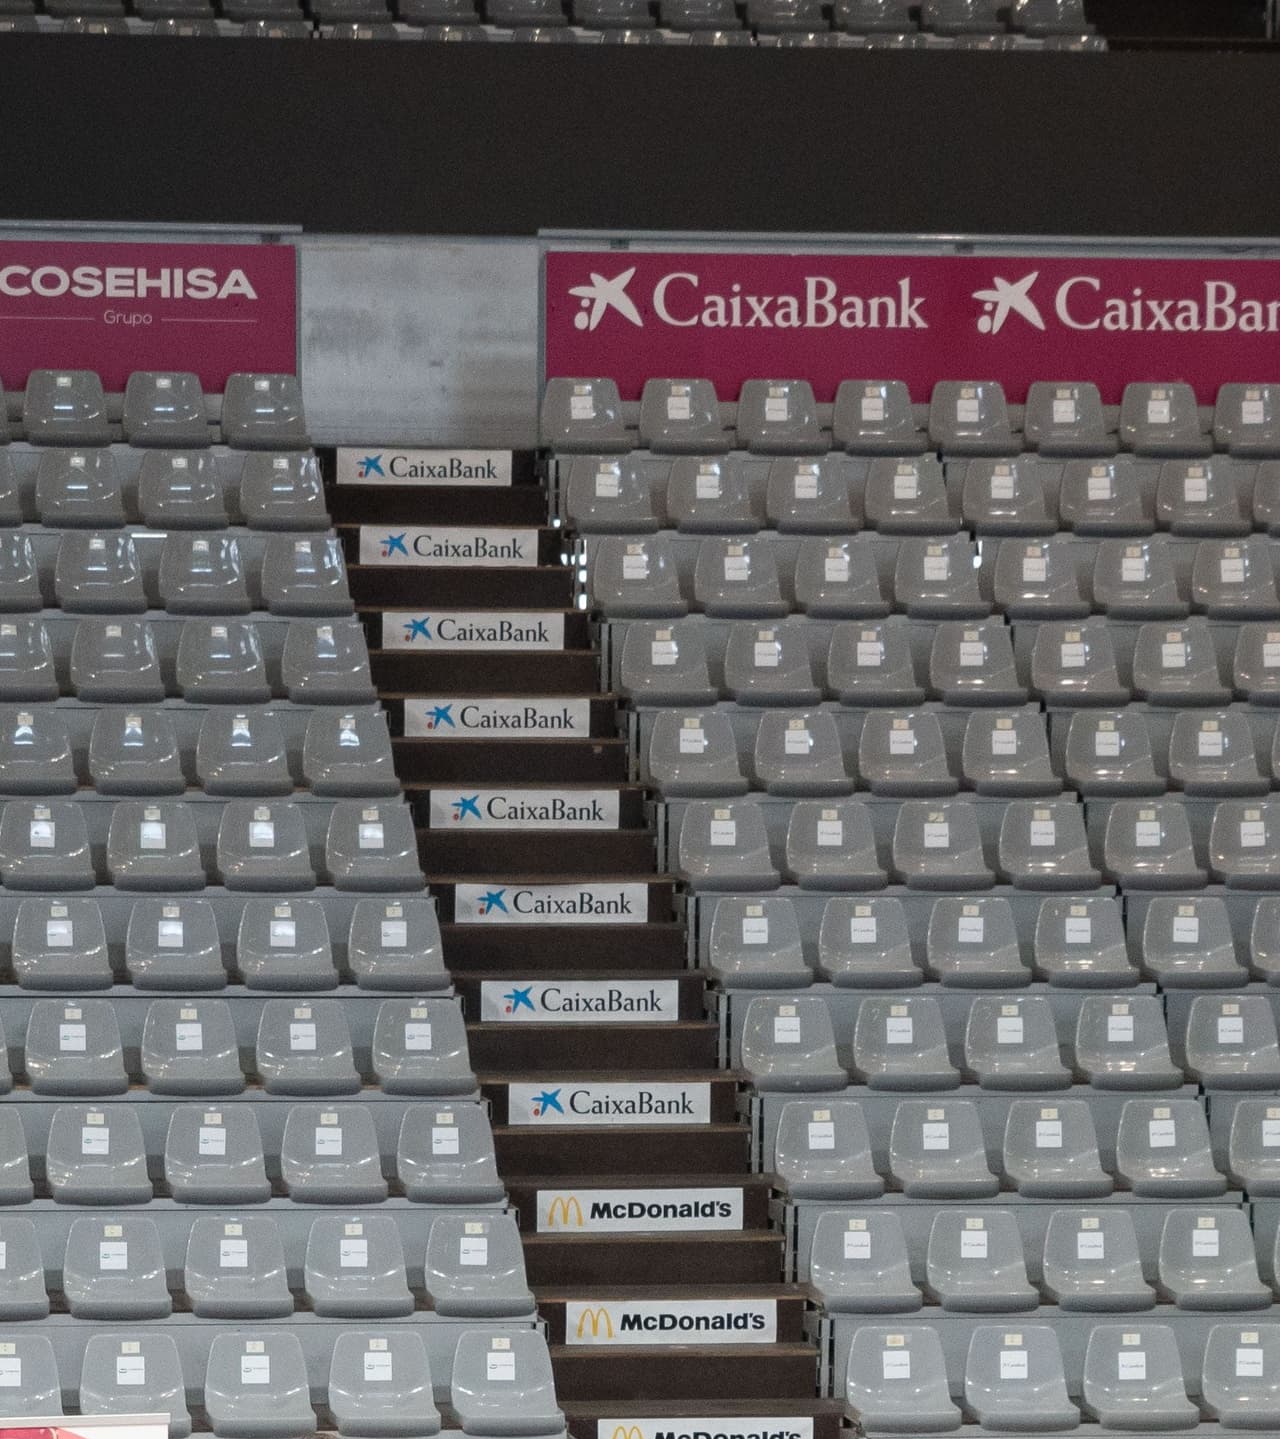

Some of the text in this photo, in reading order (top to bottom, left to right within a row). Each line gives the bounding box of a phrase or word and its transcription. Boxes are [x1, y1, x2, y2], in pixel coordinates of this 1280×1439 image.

[653, 271, 929, 329] CaixaBank
[103, 309, 153, 327] Grupo
[389, 455, 498, 480] CaixaBank
[413, 535, 524, 560] CaixaBank
[437, 618, 549, 643] CaixaBank
[460, 705, 575, 730] CaixaBank
[487, 797, 604, 822] CaixaBank
[513, 889, 632, 915] CaixaBank
[540, 987, 662, 1013] CaixaBank
[569, 1090, 695, 1115] CaixaBank
[590, 1200, 732, 1219] McDonald's
[620, 1311, 766, 1331] McDonald's
